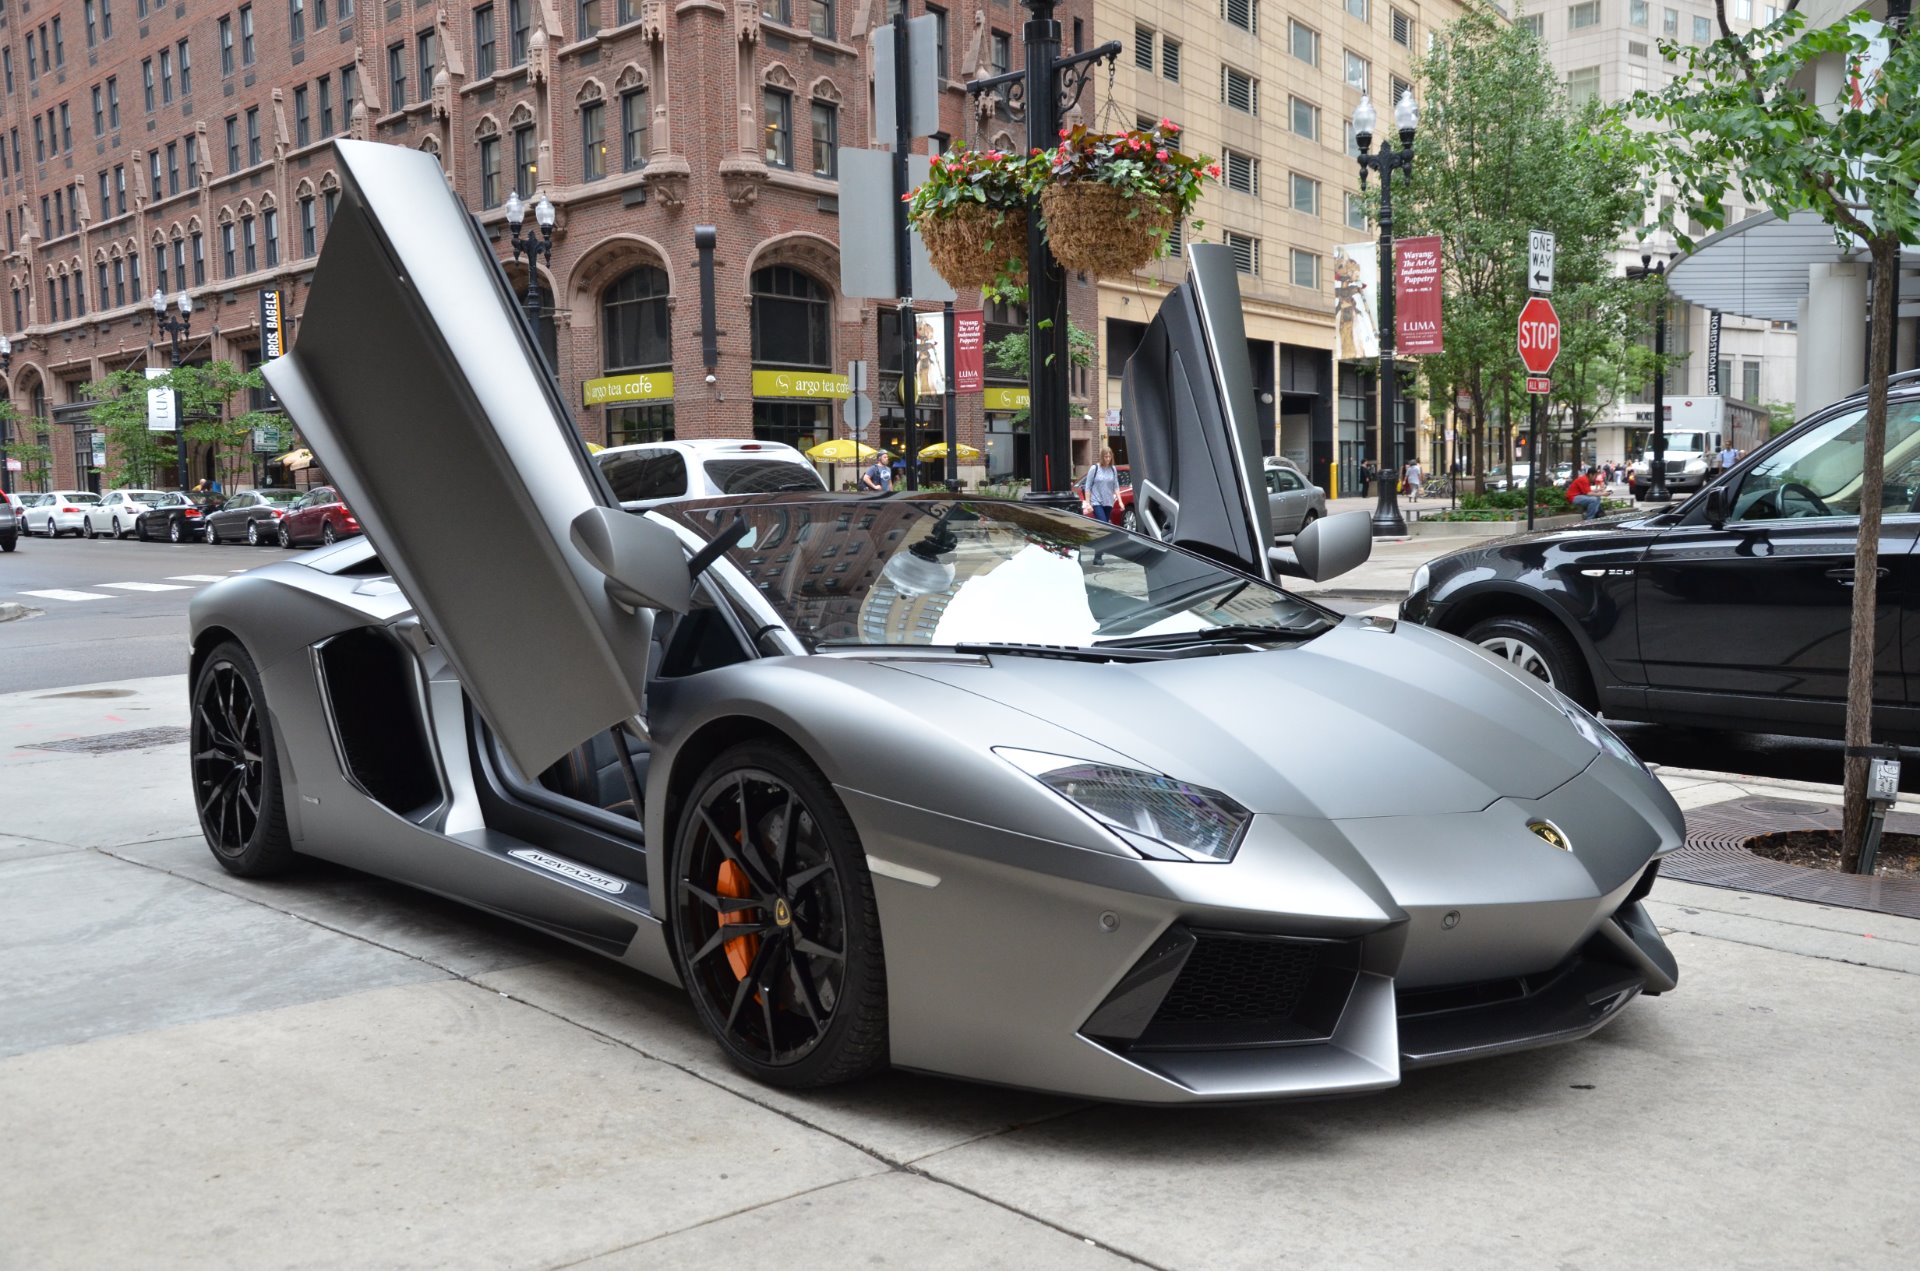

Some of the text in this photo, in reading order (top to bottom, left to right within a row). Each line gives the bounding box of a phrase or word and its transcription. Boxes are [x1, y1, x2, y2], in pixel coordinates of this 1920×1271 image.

[1533, 236, 1551, 252] ONE
[1428, 257, 1437, 267] of
[1532, 253, 1551, 268] WAY
[1401, 267, 1437, 275] Indonesian
[1404, 276, 1434, 284] Puppetry
[265, 292, 280, 357] BROS. BAGELS
[1404, 321, 1435, 331] LUMA
[1521, 321, 1557, 350] STOP
[1708, 315, 1719, 372] NORDSTROM
[959, 370, 978, 378] LUMA
[592, 375, 652, 401] argo tea café
[795, 380, 820, 395] argo
[822, 379, 834, 392] tea
[1528, 381, 1548, 391] ALL WAY
[526, 854, 613, 886] AVENTADOR
